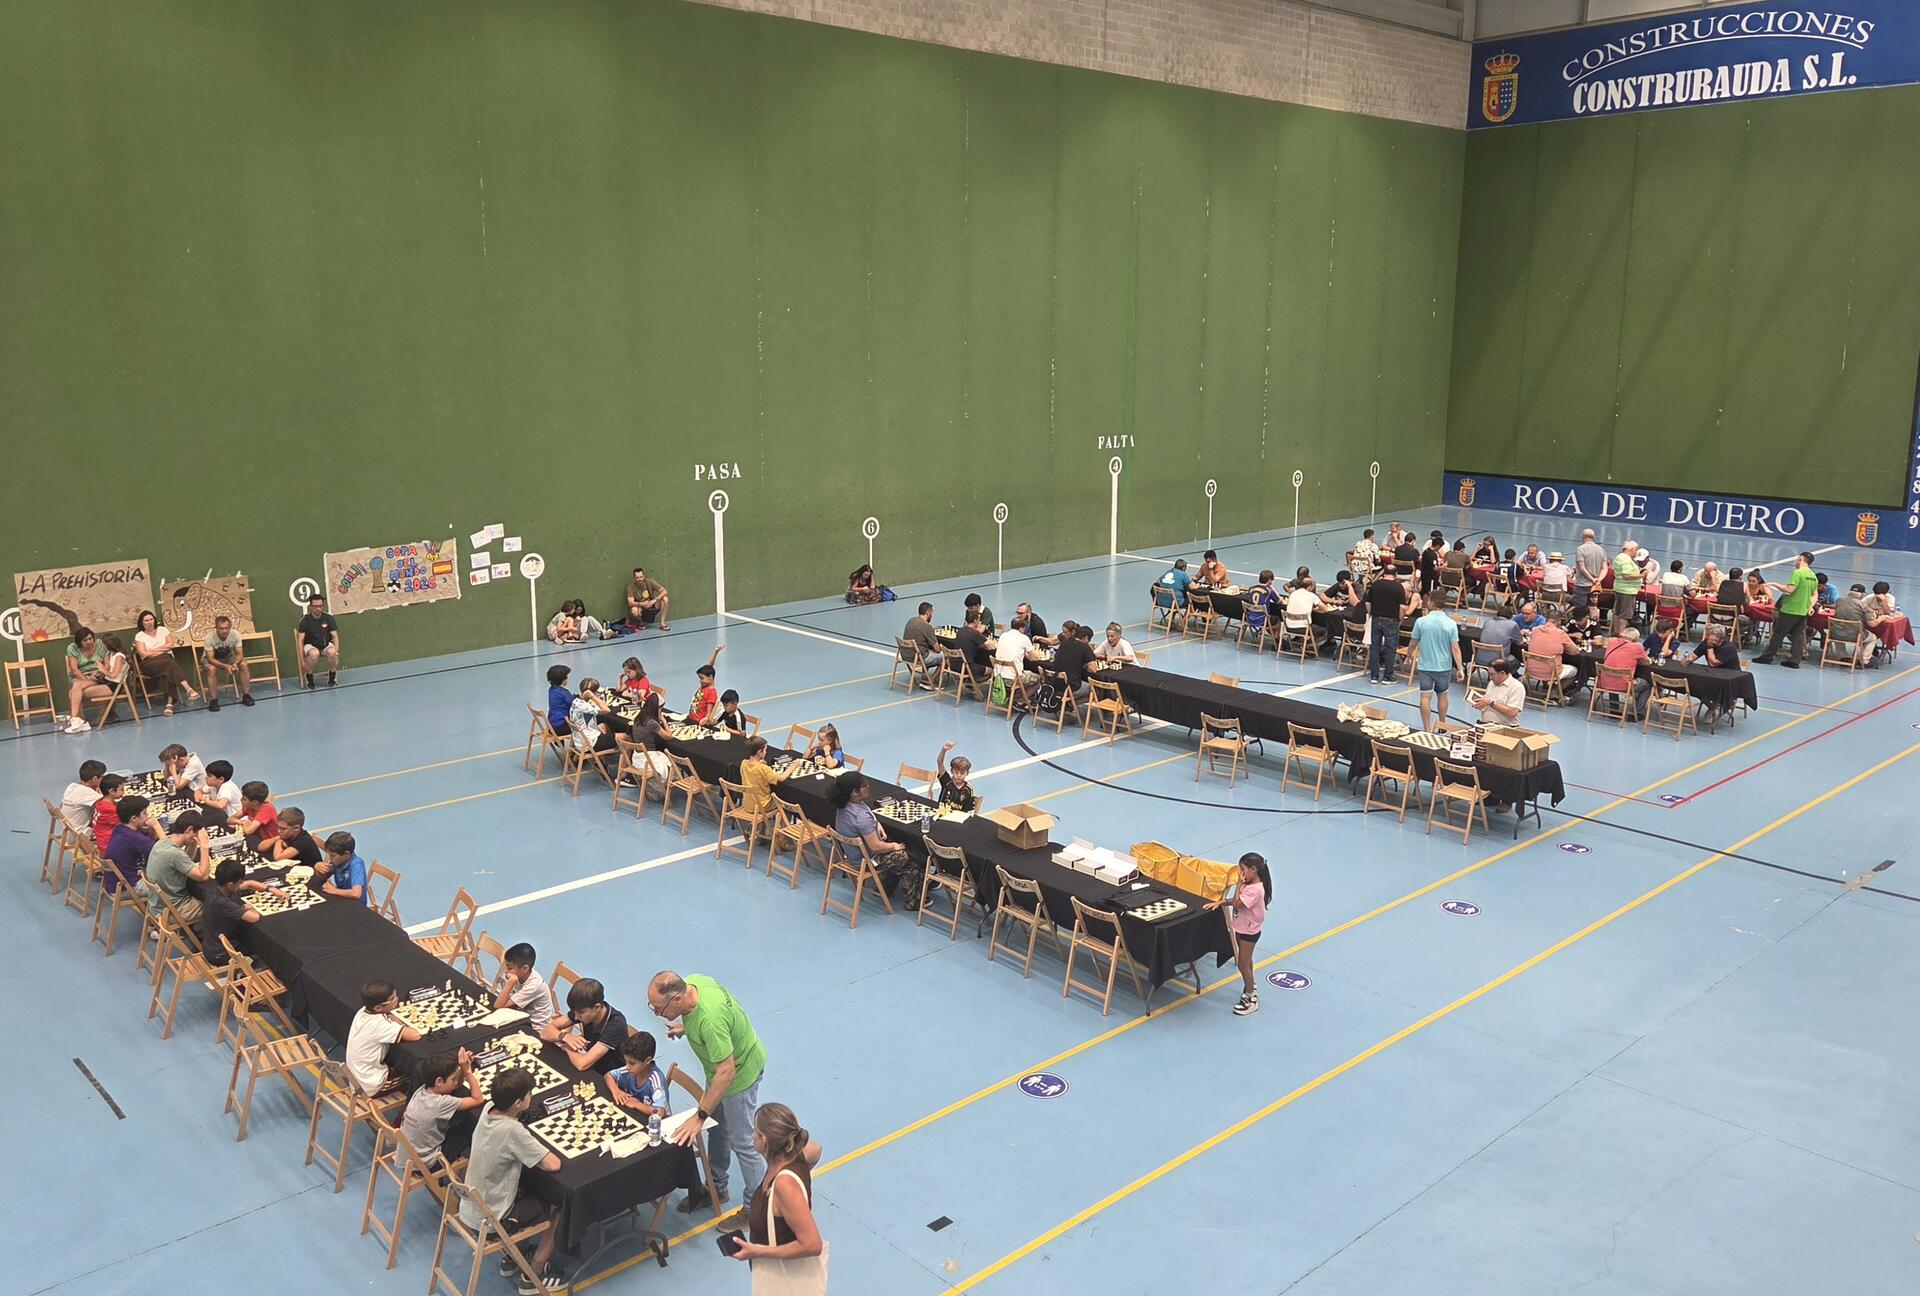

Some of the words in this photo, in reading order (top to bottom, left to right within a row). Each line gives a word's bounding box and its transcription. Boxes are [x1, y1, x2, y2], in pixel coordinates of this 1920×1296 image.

[1563, 11, 1875, 81] CONSTRUCCIONES
[1573, 61, 1791, 114] CONSTRURAUDA
[1803, 52, 1857, 90] S.L.
[694, 462, 741, 481] PASA
[1112, 460, 1119, 472] 4
[714, 495, 723, 509] 7
[1513, 484, 1583, 515] ROA
[1599, 491, 1648, 521] DE
[1668, 497, 1805, 536] DUERO
[867, 521, 875, 534] 6
[19, 574, 46, 594] LA
[299, 584, 311, 600] 9
[404, 576, 437, 592] 2026
